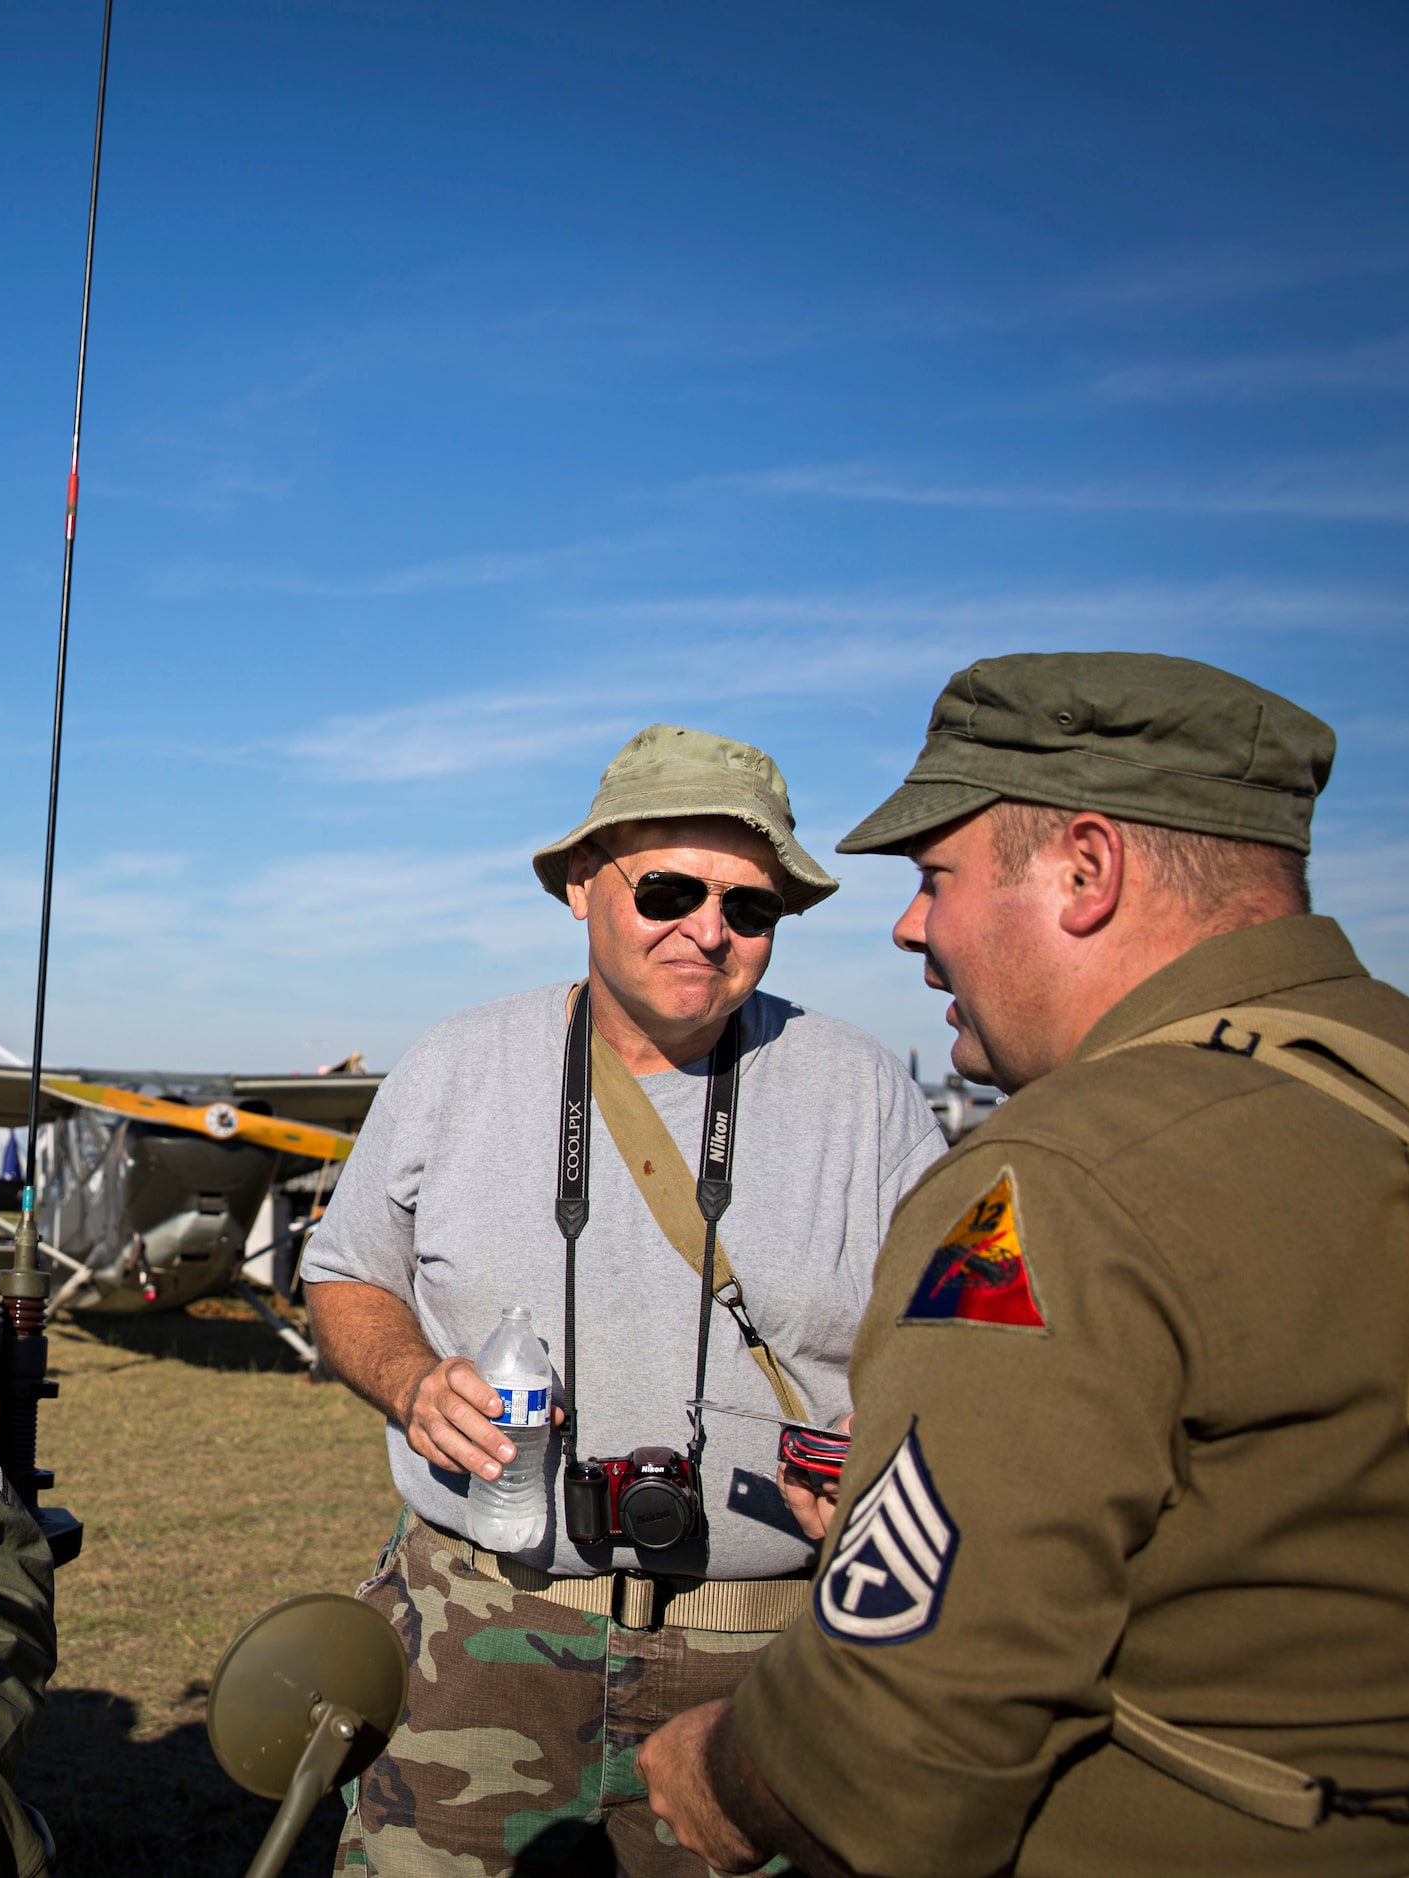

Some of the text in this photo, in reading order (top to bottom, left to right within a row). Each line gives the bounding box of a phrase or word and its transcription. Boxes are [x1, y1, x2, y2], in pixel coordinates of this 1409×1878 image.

[567, 1100, 583, 1181] COOLPIX
[709, 1111, 729, 1163] Nikon
[968, 1201, 1004, 1231] 12
[641, 1464, 664, 1473] Nikon
[842, 1560, 888, 1612] T
